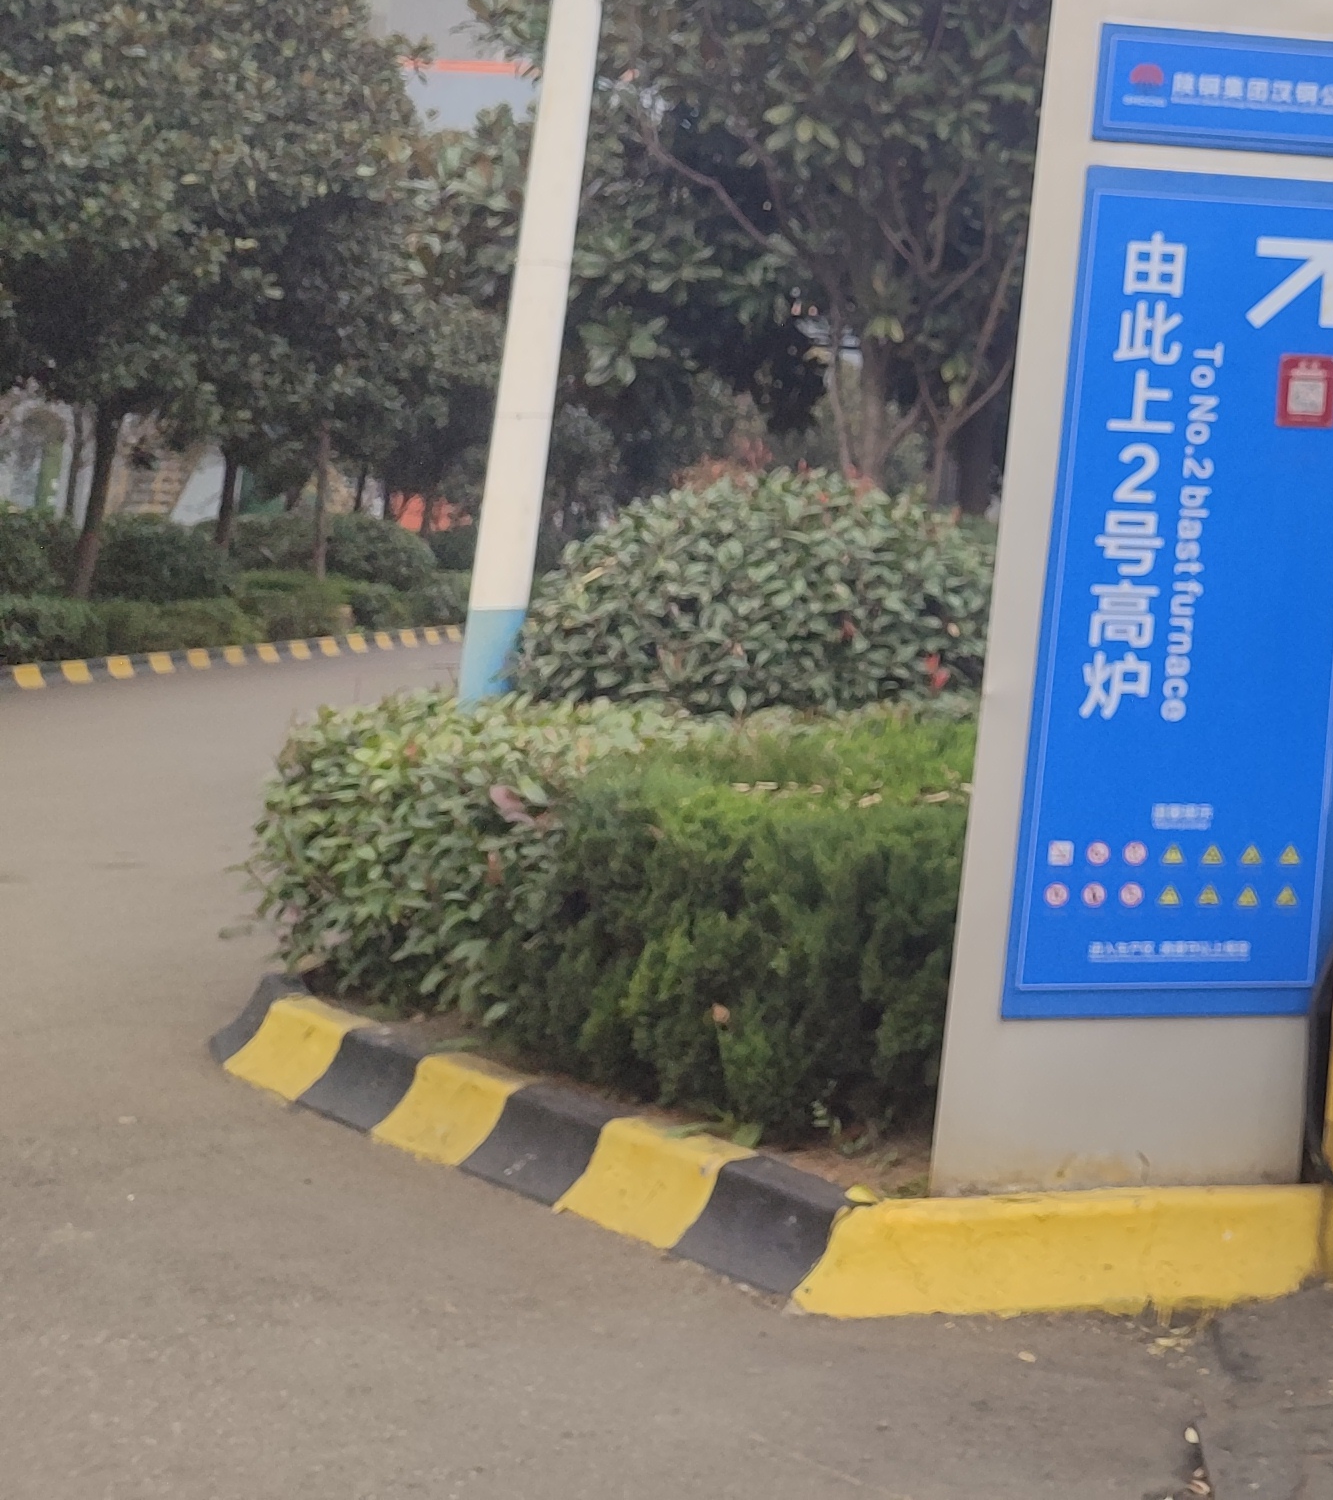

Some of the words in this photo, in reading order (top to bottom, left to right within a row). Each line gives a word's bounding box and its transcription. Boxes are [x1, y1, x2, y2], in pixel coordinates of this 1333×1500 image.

[1193, 342, 1225, 389] To
[1079, 230, 1187, 720] 由此上2号高炉
[1182, 394, 1220, 480] No.2
[1173, 484, 1213, 575] blast
